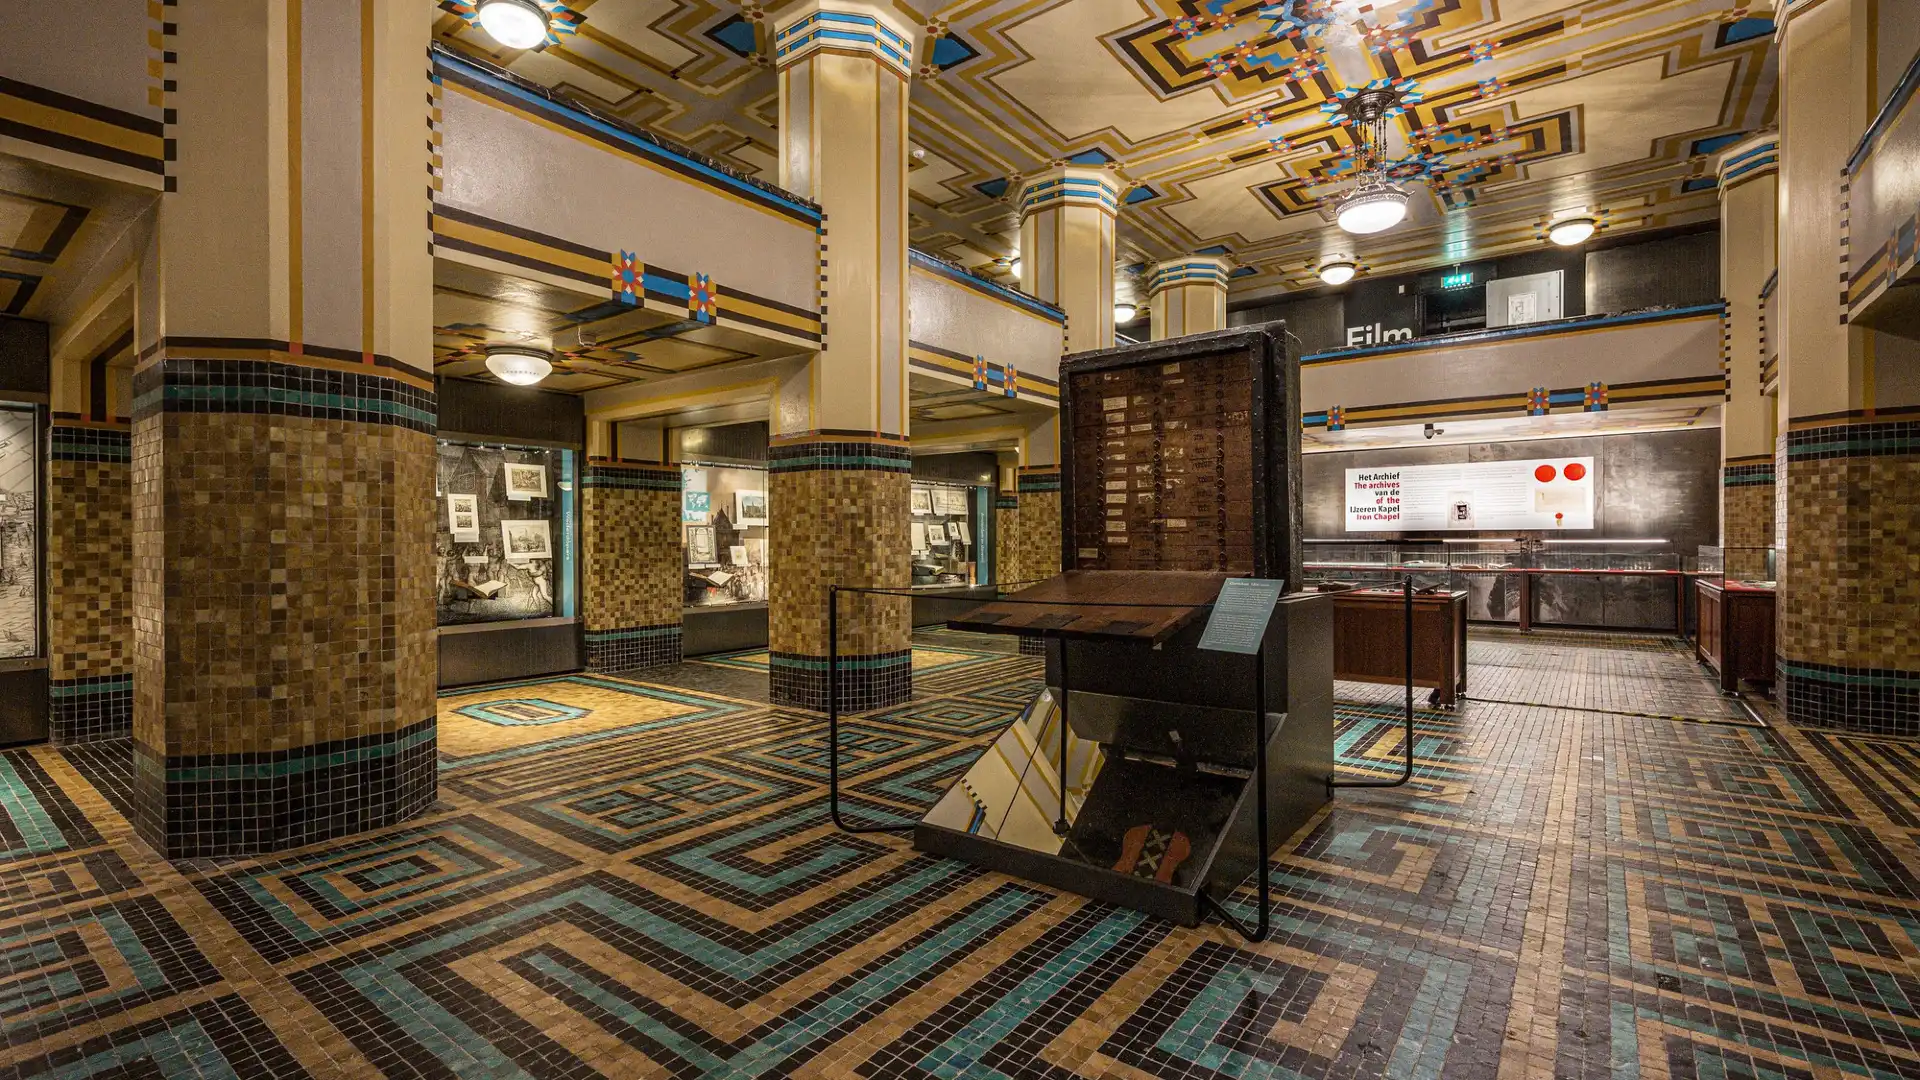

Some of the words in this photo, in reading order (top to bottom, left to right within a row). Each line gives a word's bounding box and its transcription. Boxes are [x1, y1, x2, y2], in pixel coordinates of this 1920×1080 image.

[1346, 322, 1412, 346] Film
[1373, 472, 1400, 480] Archief
[1378, 504, 1400, 514] Kapel
[1374, 513, 1400, 521] Chapel
